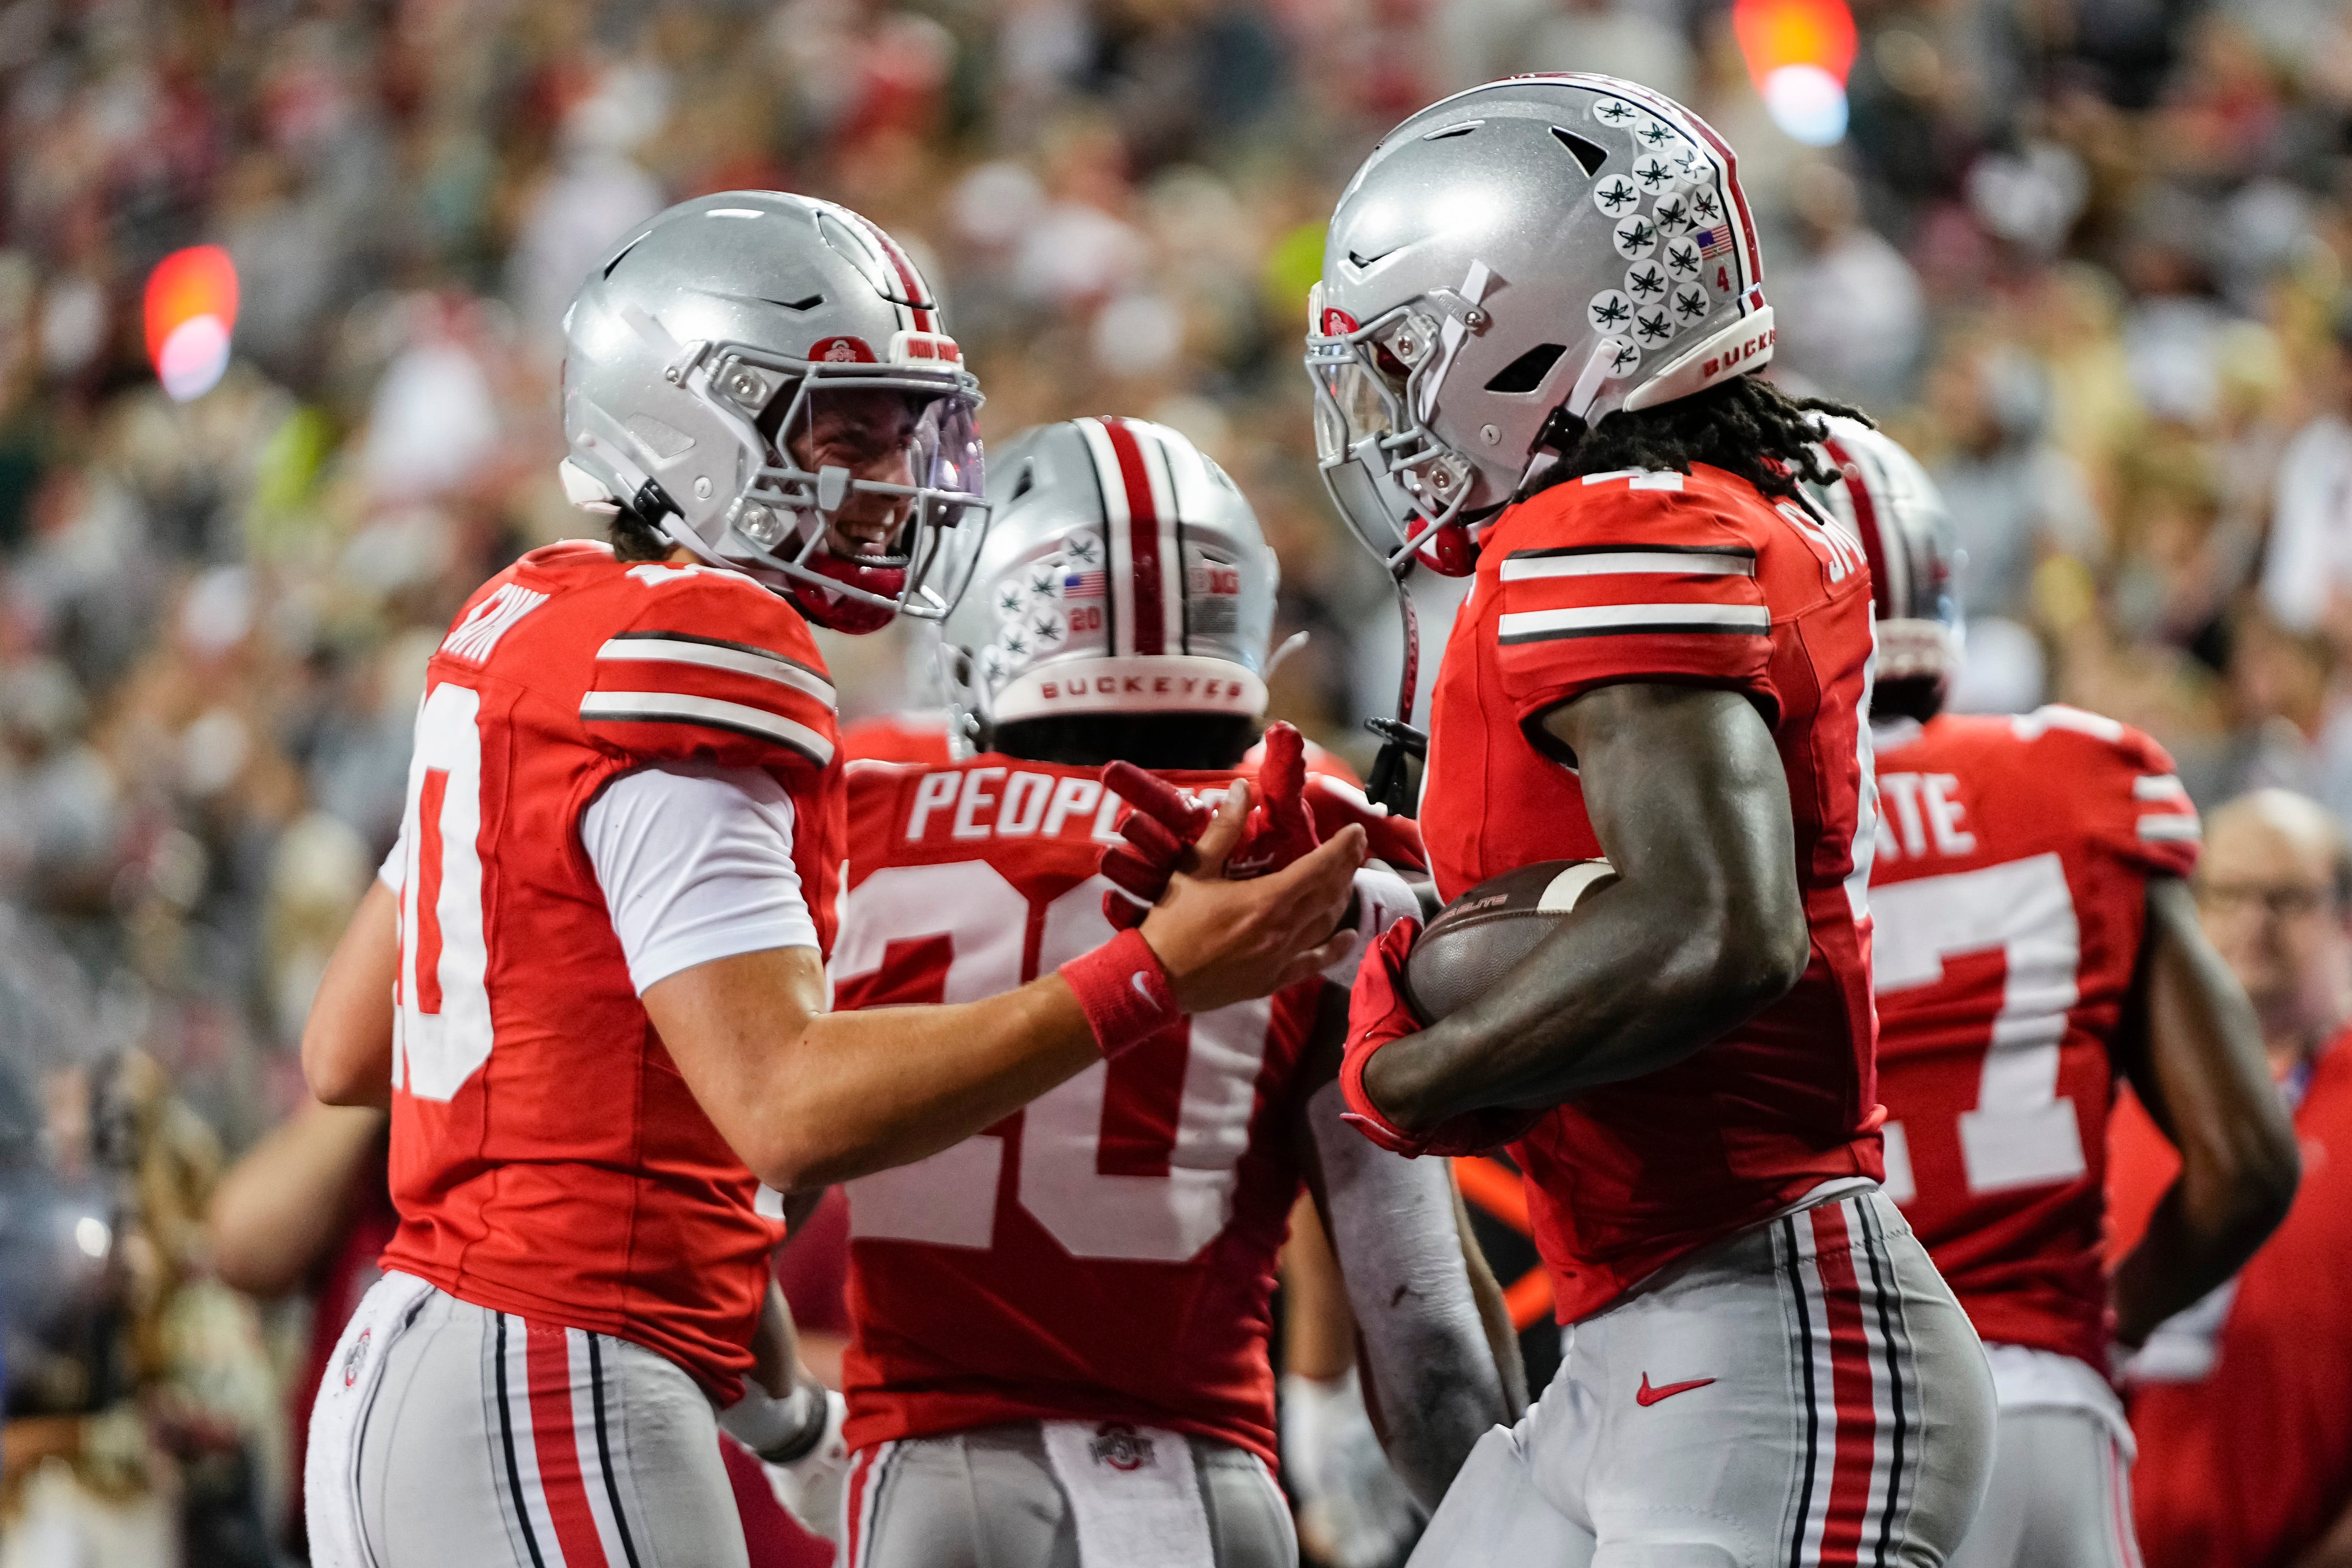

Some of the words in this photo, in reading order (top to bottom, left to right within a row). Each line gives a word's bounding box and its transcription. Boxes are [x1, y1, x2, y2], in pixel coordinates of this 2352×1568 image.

[1716, 266, 1730, 292] 4
[1069, 606, 1101, 631] 20
[1042, 677, 1242, 699] BUCKEYES
[906, 767, 1229, 844] PEOPL
[1456, 894, 1508, 915] ELITE
[1869, 852, 2088, 1204] 7
[834, 859, 1272, 1262] 20
